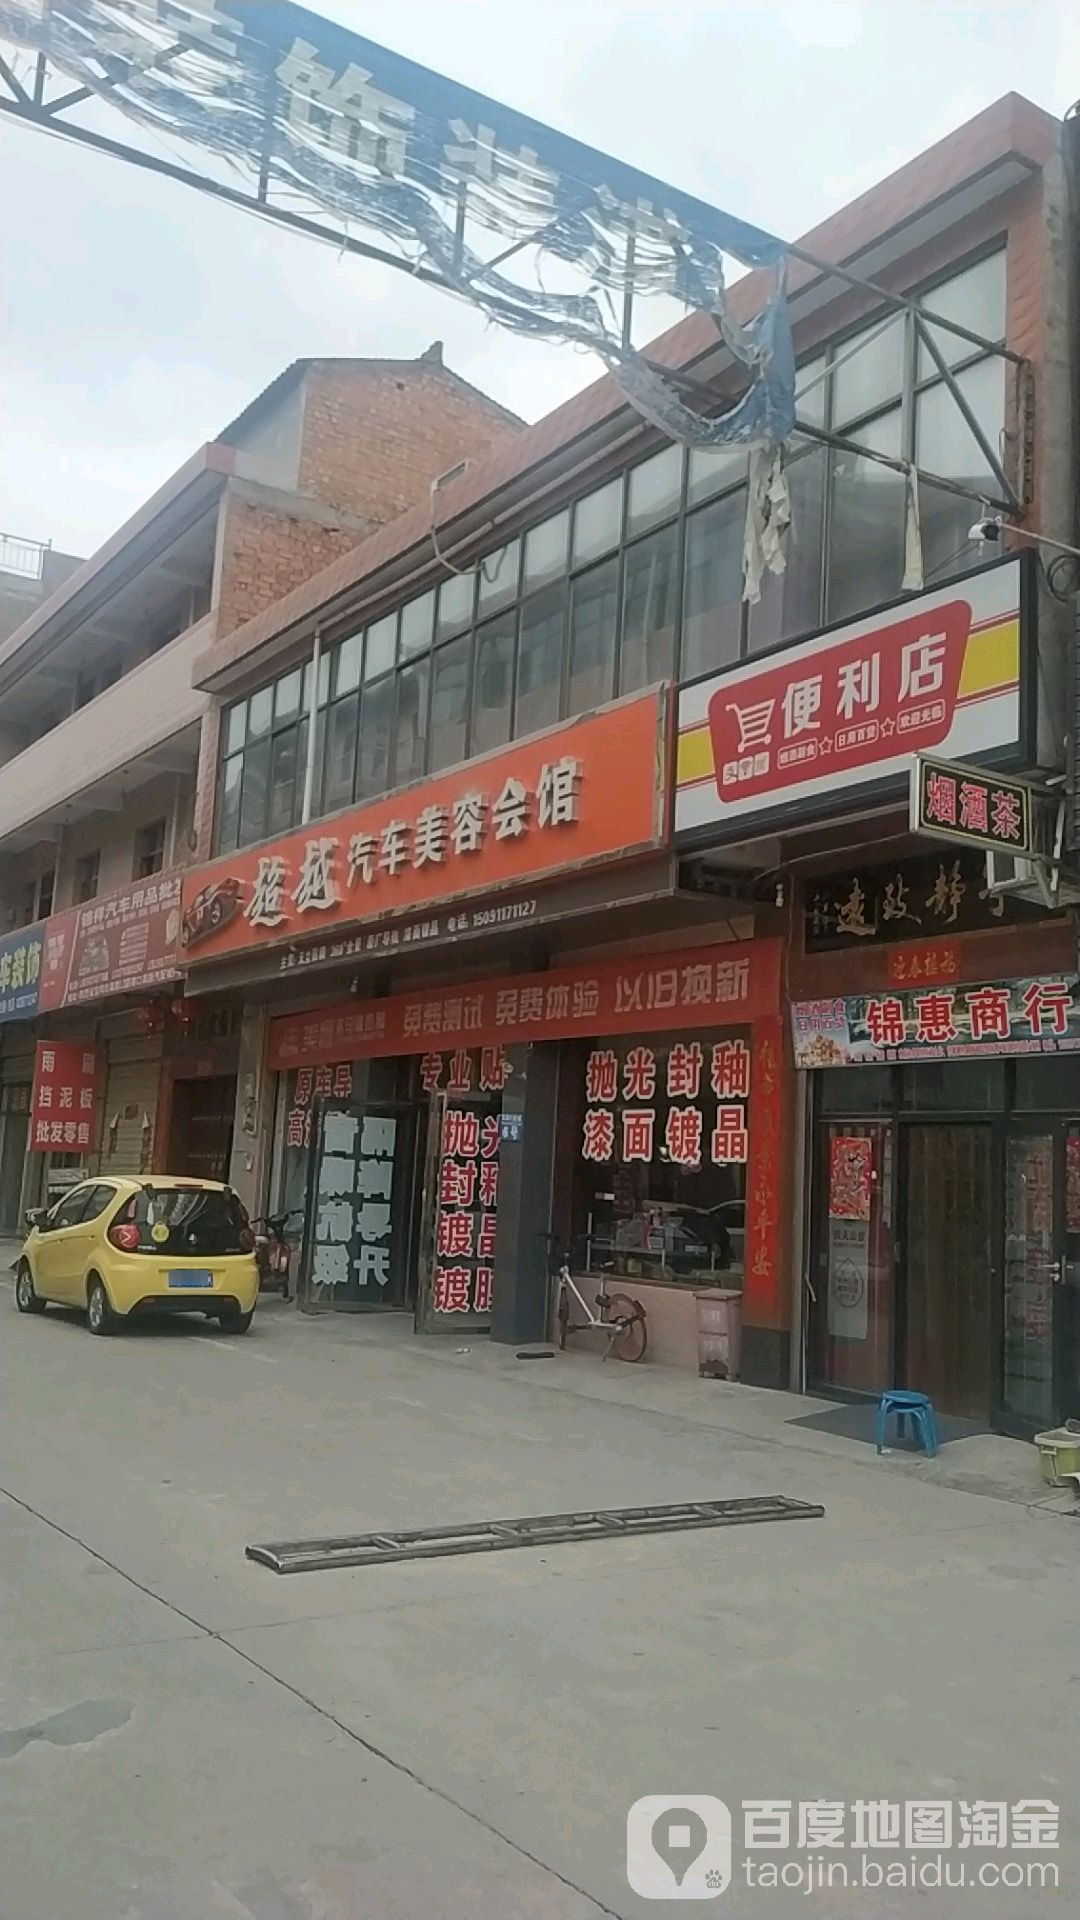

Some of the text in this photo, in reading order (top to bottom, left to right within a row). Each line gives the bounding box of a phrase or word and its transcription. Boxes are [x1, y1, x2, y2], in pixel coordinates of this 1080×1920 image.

[781, 632, 947, 739] 便利店
[926, 771, 1022, 841] 烟酒茶
[402, 994, 484, 1038] 免费测试
[495, 979, 600, 1027] 免费体验
[614, 957, 751, 1014] 以旧换新
[865, 982, 1073, 1047] 锦惠商行
[38, 1084, 94, 1109] 挡泥板
[586, 1039, 751, 1102] 抛光封釉
[35, 1119, 90, 1145] 批发零售
[582, 1104, 749, 1165] 漆面镀晶
